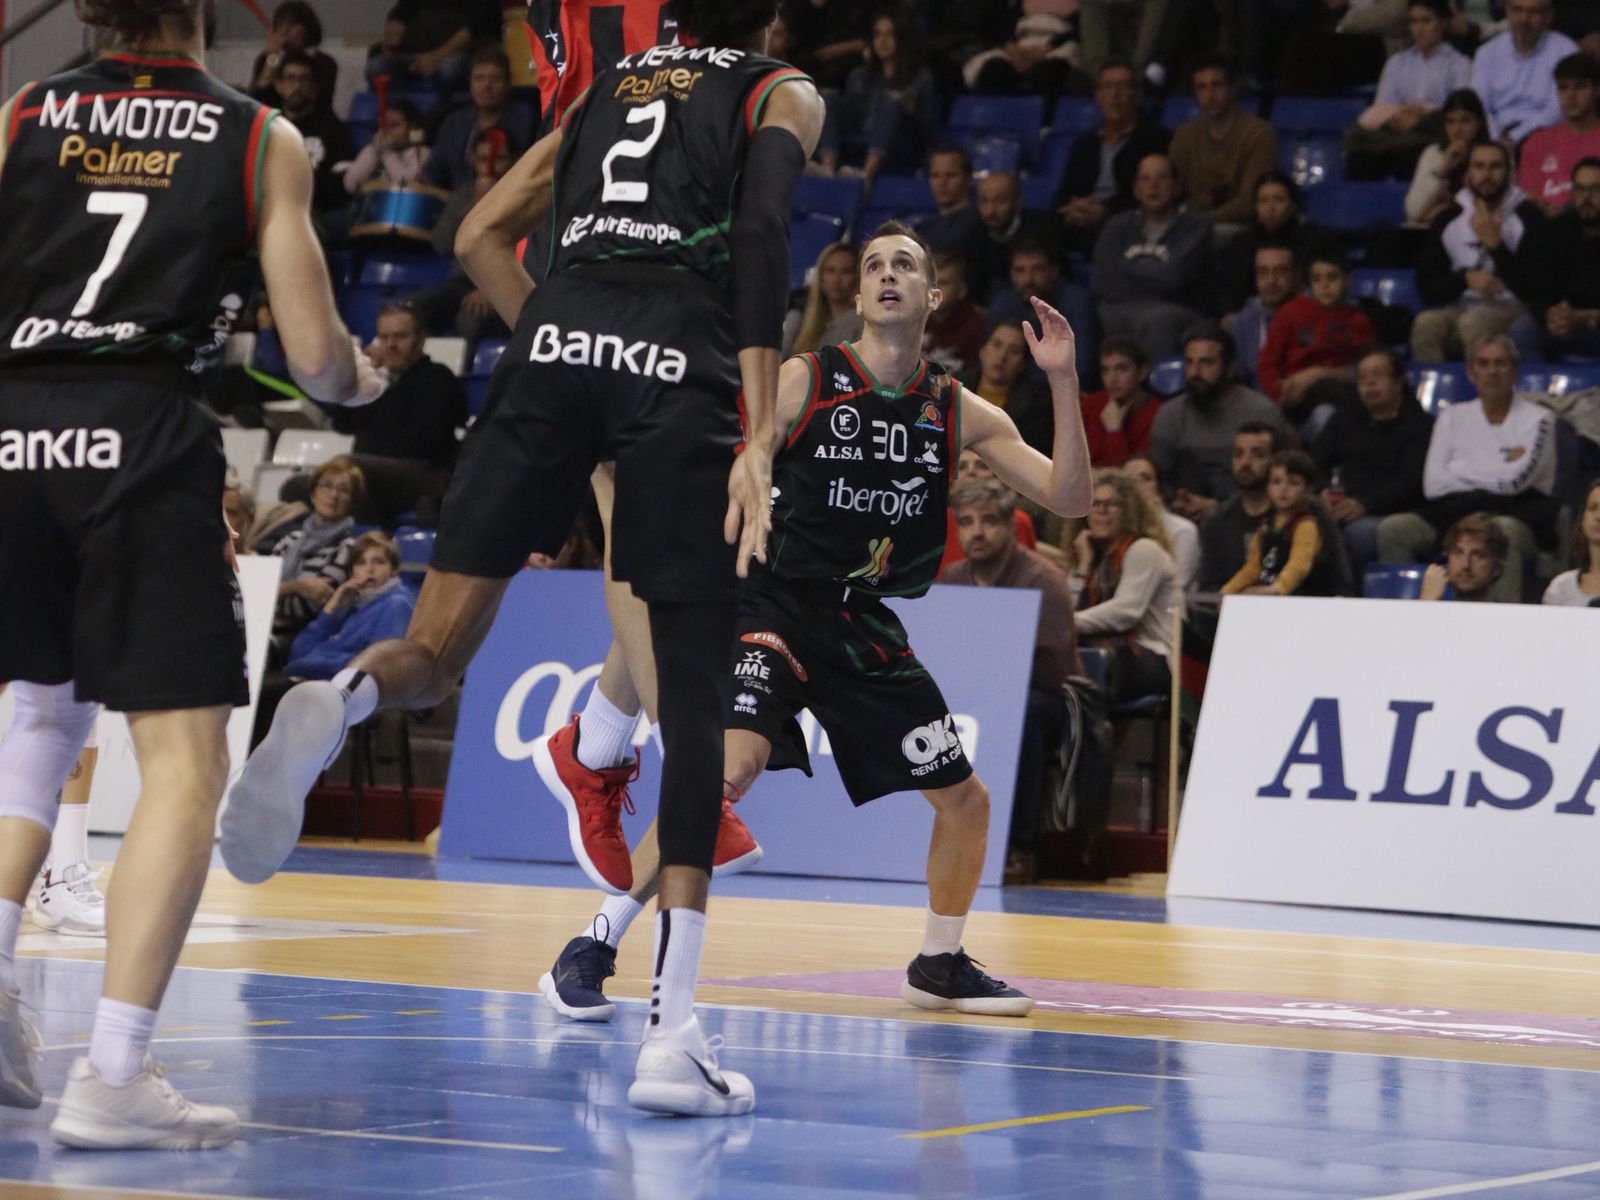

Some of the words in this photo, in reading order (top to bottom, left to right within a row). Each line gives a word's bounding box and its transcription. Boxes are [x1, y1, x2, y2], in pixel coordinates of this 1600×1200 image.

[614, 67, 703, 97] Palmer
[616, 54, 632, 69] J.
[39, 89, 80, 129] M.
[89, 94, 224, 142] MOTOS
[58, 134, 182, 176] Palmer
[602, 100, 665, 203] 2
[71, 191, 148, 317] 7
[529, 323, 687, 384] Bankia
[814, 445, 863, 460] ALSA
[872, 420, 908, 463] 30
[828, 477, 928, 525] iberojet
[734, 663, 771, 680] IME
[911, 760, 939, 777] RENT
[941, 756, 950, 766] A
